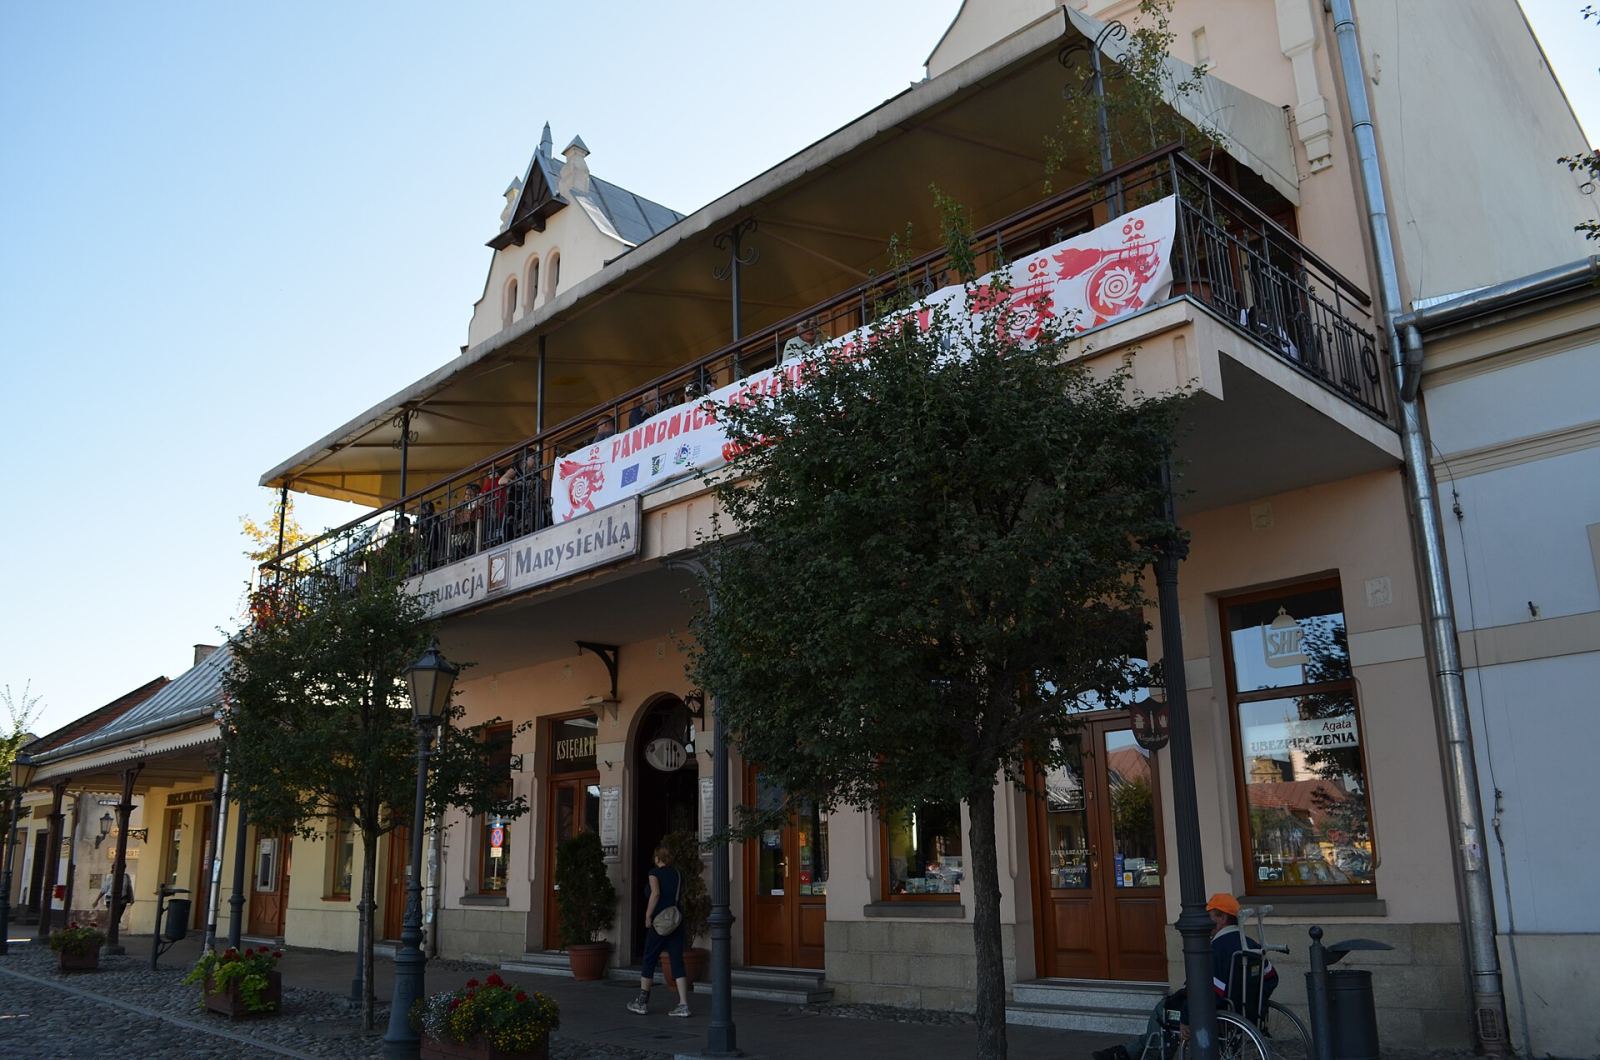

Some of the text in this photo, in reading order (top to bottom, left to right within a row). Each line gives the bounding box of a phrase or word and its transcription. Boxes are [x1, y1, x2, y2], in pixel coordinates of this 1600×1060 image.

[611, 401, 717, 463] PANNONICA
[1251, 732, 1356, 752] UBEZPIECZENIA
[1322, 720, 1352, 742] Agata
[556, 735, 597, 762] KSIĘGARN
